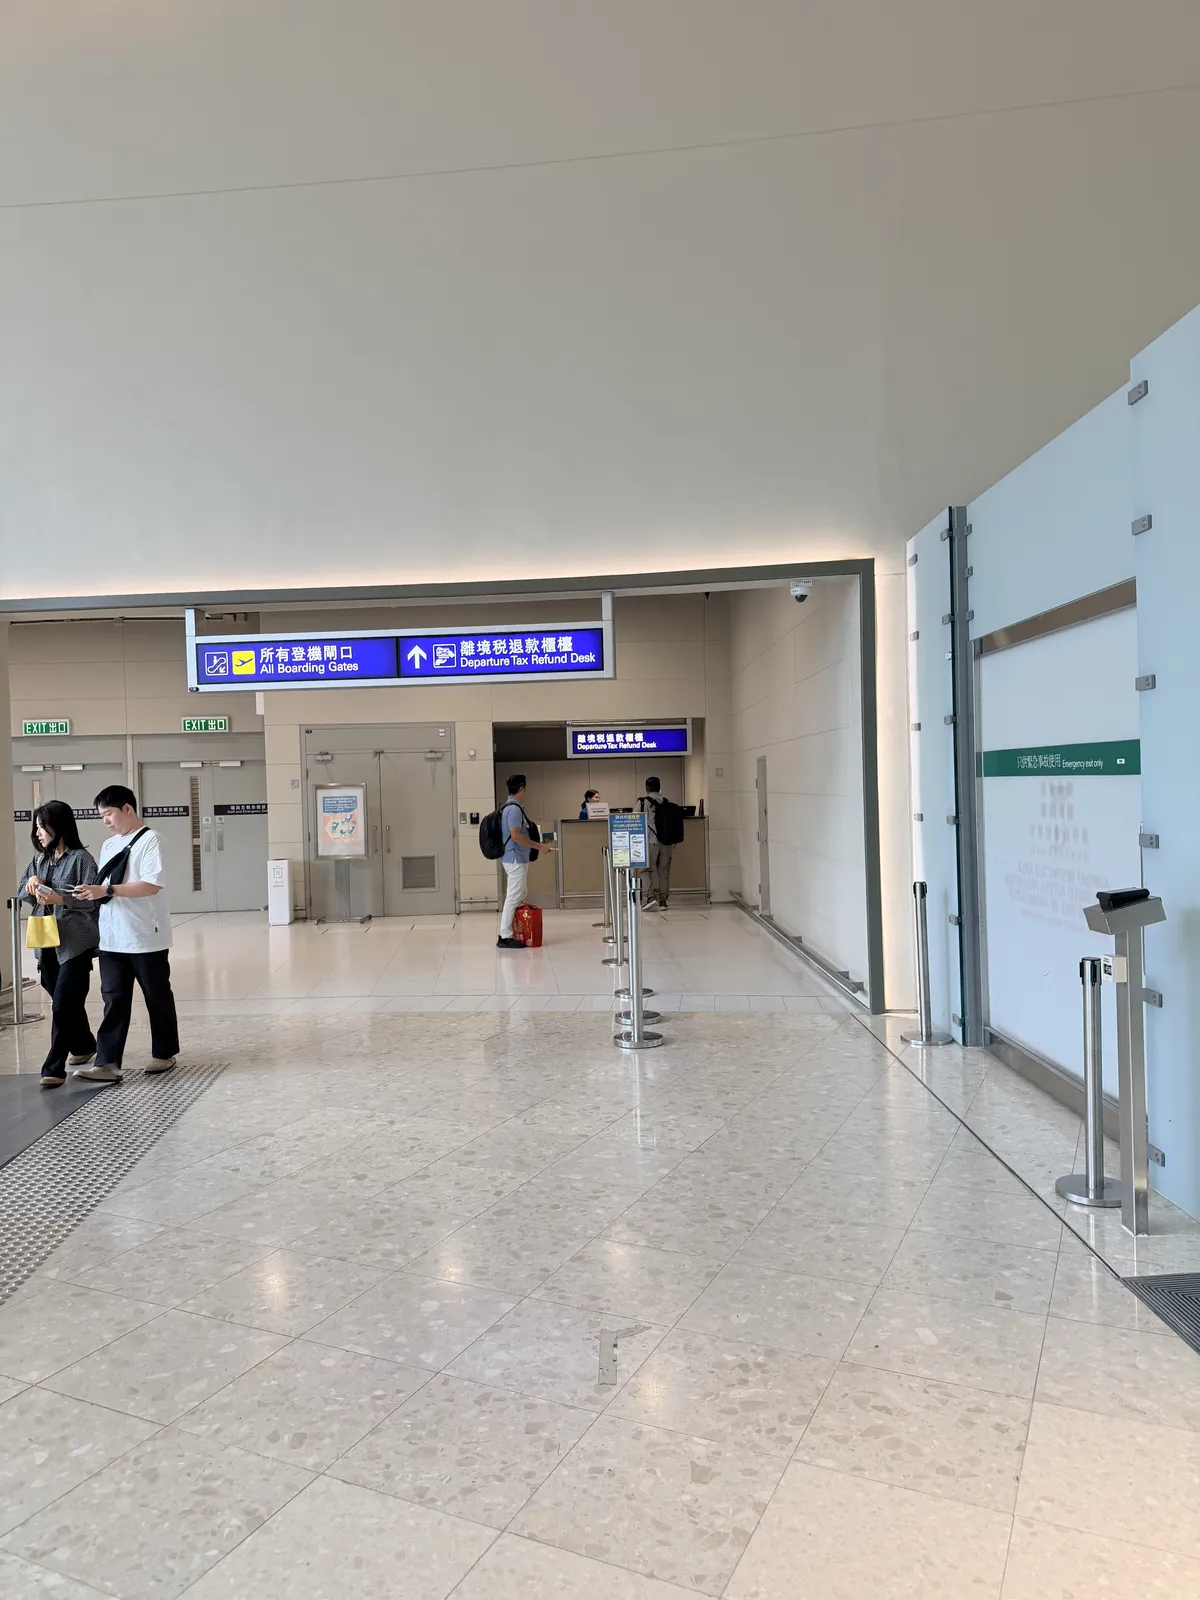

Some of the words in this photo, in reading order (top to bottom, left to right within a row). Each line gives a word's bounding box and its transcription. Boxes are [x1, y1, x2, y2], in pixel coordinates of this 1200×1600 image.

[260, 646, 352, 663] 所有登機閘口
[460, 658, 510, 669] Departure
[511, 656, 528, 666] Tax
[532, 654, 568, 665] Refund
[571, 652, 596, 663] Desk
[260, 664, 274, 674] All
[278, 662, 325, 674] Boarding
[328, 662, 358, 672] Gates
[26, 722, 47, 734] EXIT
[49, 723, 66, 733] 出口
[185, 720, 206, 730] EXIT
[208, 720, 224, 730] 出口
[1062, 760, 1085, 770] Emergency
[1094, 758, 1103, 770] only
